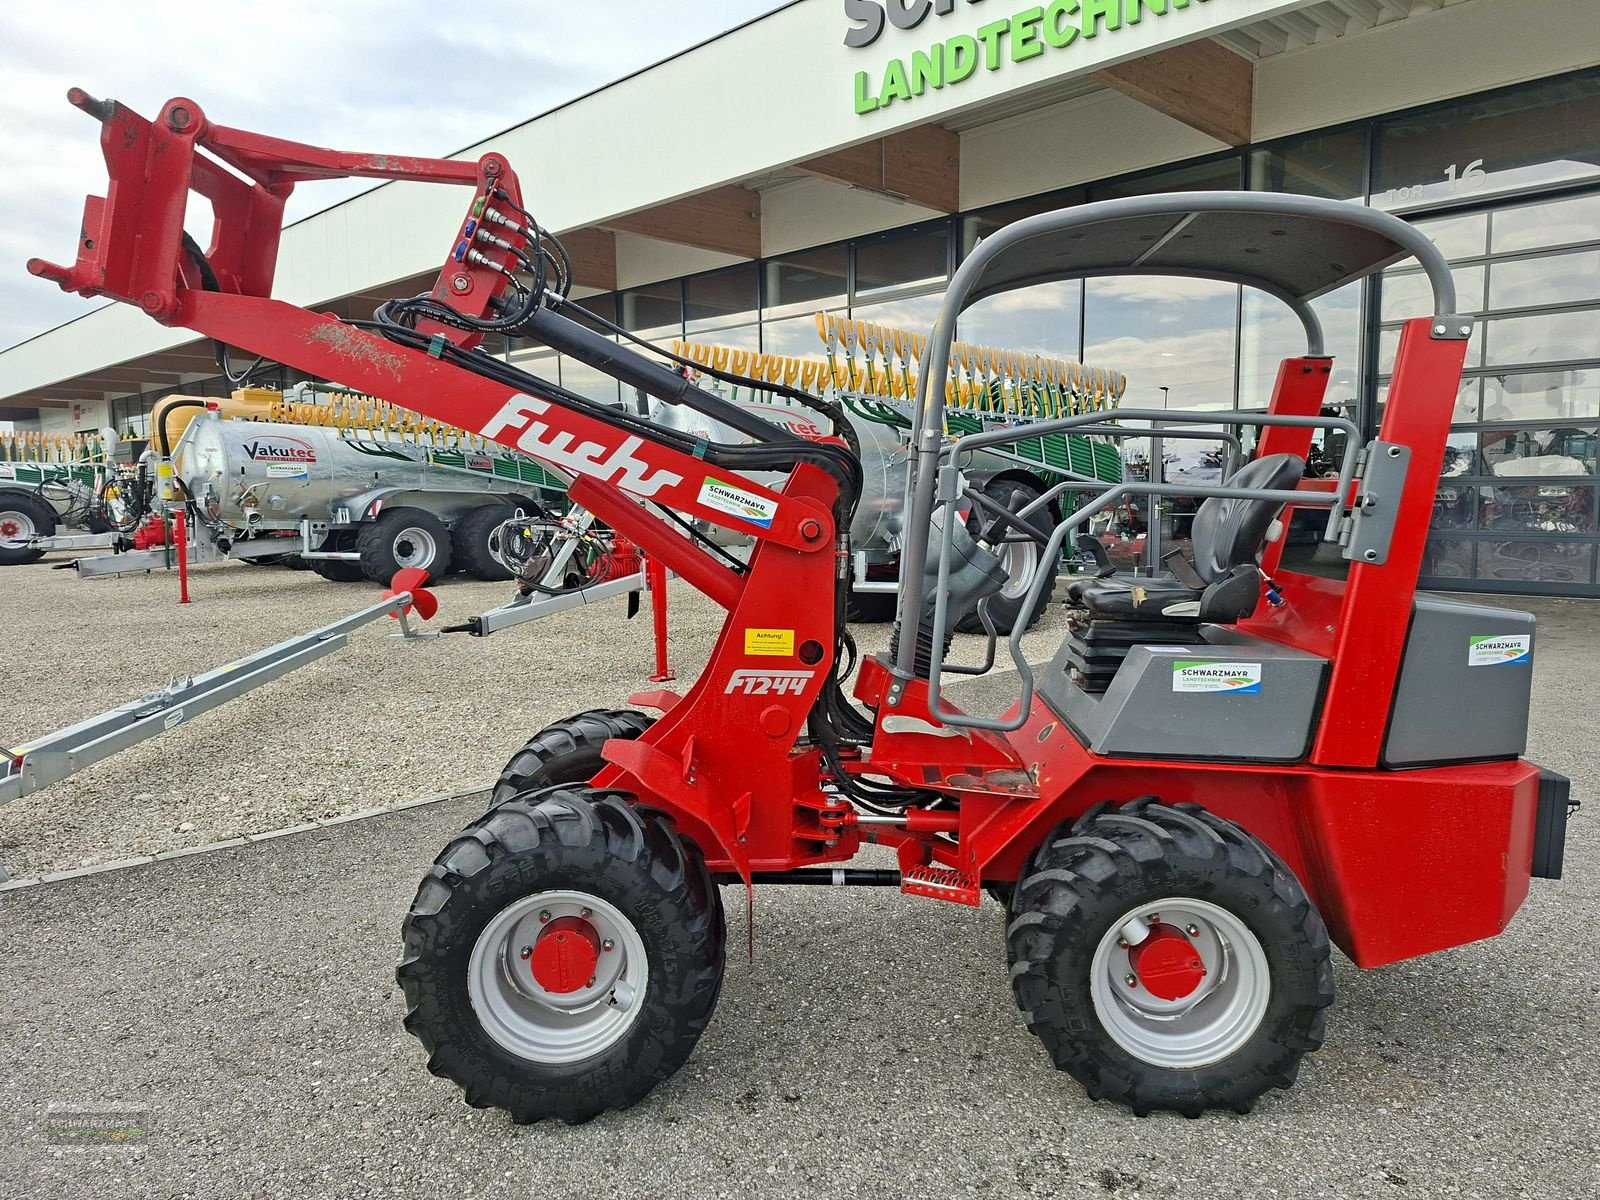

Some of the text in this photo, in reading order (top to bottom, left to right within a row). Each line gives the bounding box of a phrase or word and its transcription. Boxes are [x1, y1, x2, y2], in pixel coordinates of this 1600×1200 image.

[844, 0, 985, 48] SC
[854, 0, 1211, 115] LANDTECH
[1386, 159, 1486, 202] TOR 16
[242, 441, 316, 460] Vakutec
[479, 393, 685, 496] Fuchs
[707, 492, 741, 508] LANDTECHNIK
[708, 485, 766, 511] SCHWARZMAYR
[756, 632, 784, 640] Achtung!
[1476, 642, 1521, 650] SCHWARZMAYR
[723, 669, 816, 696] F1244
[1181, 669, 1249, 677] SCHWARZMAYR
